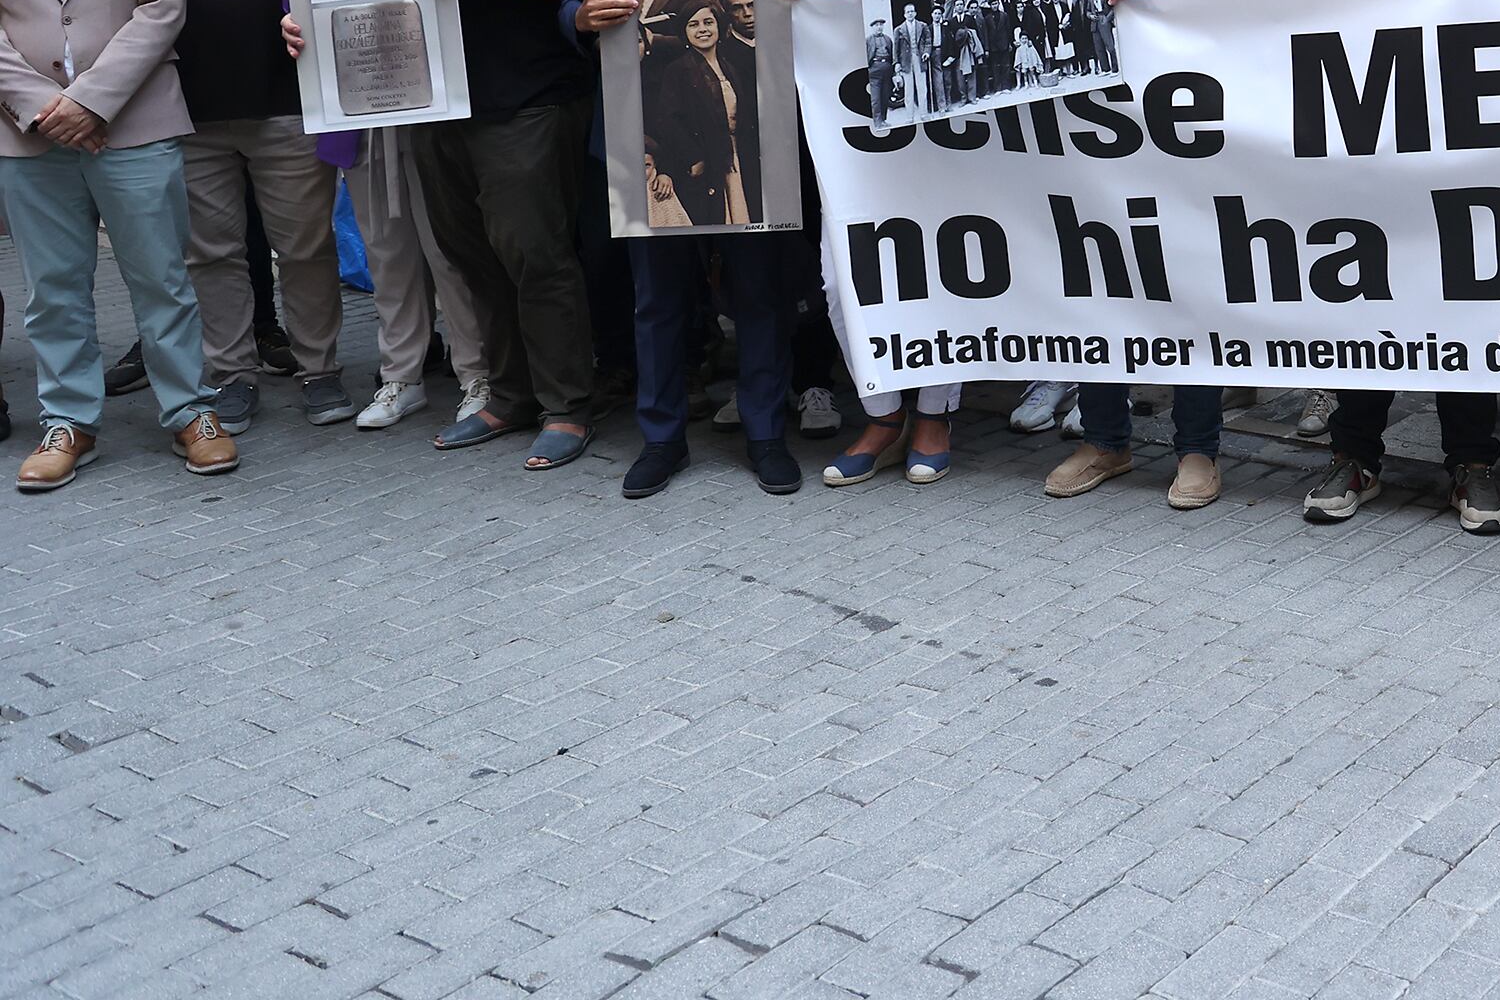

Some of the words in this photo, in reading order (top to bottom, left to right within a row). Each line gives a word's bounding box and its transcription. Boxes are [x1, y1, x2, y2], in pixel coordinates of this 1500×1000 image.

[846, 213, 1012, 307] no
[1047, 192, 1173, 304] hi
[1212, 194, 1394, 305] ha
[1123, 335, 1195, 374] per
[1208, 331, 1252, 368] la
[1265, 331, 1470, 374] memòria
